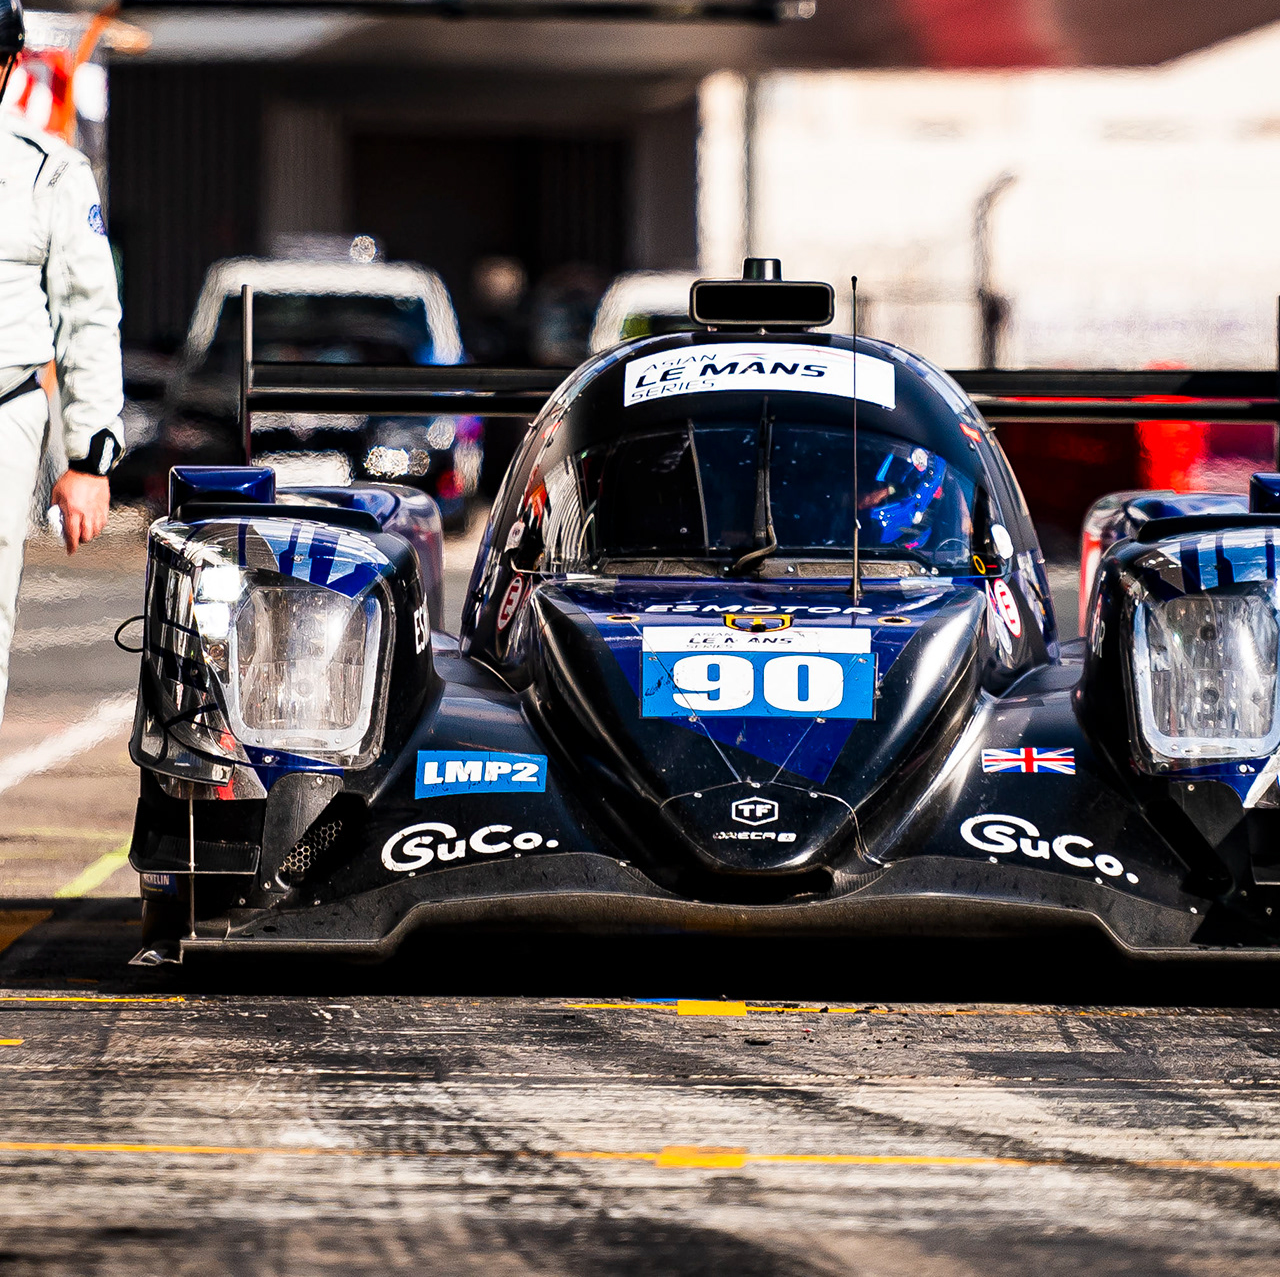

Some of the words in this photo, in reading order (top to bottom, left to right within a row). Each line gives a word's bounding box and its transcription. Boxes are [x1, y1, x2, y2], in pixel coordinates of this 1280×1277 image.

[635, 366, 687, 389] LE
[699, 362, 829, 379] MANS
[642, 354, 717, 374] ASIAN
[630, 378, 715, 403] SERIES
[644, 604, 873, 615] ESMOTOR
[673, 654, 844, 712] 90
[423, 760, 540, 785] LMP2
[738, 804, 772, 817] TF
